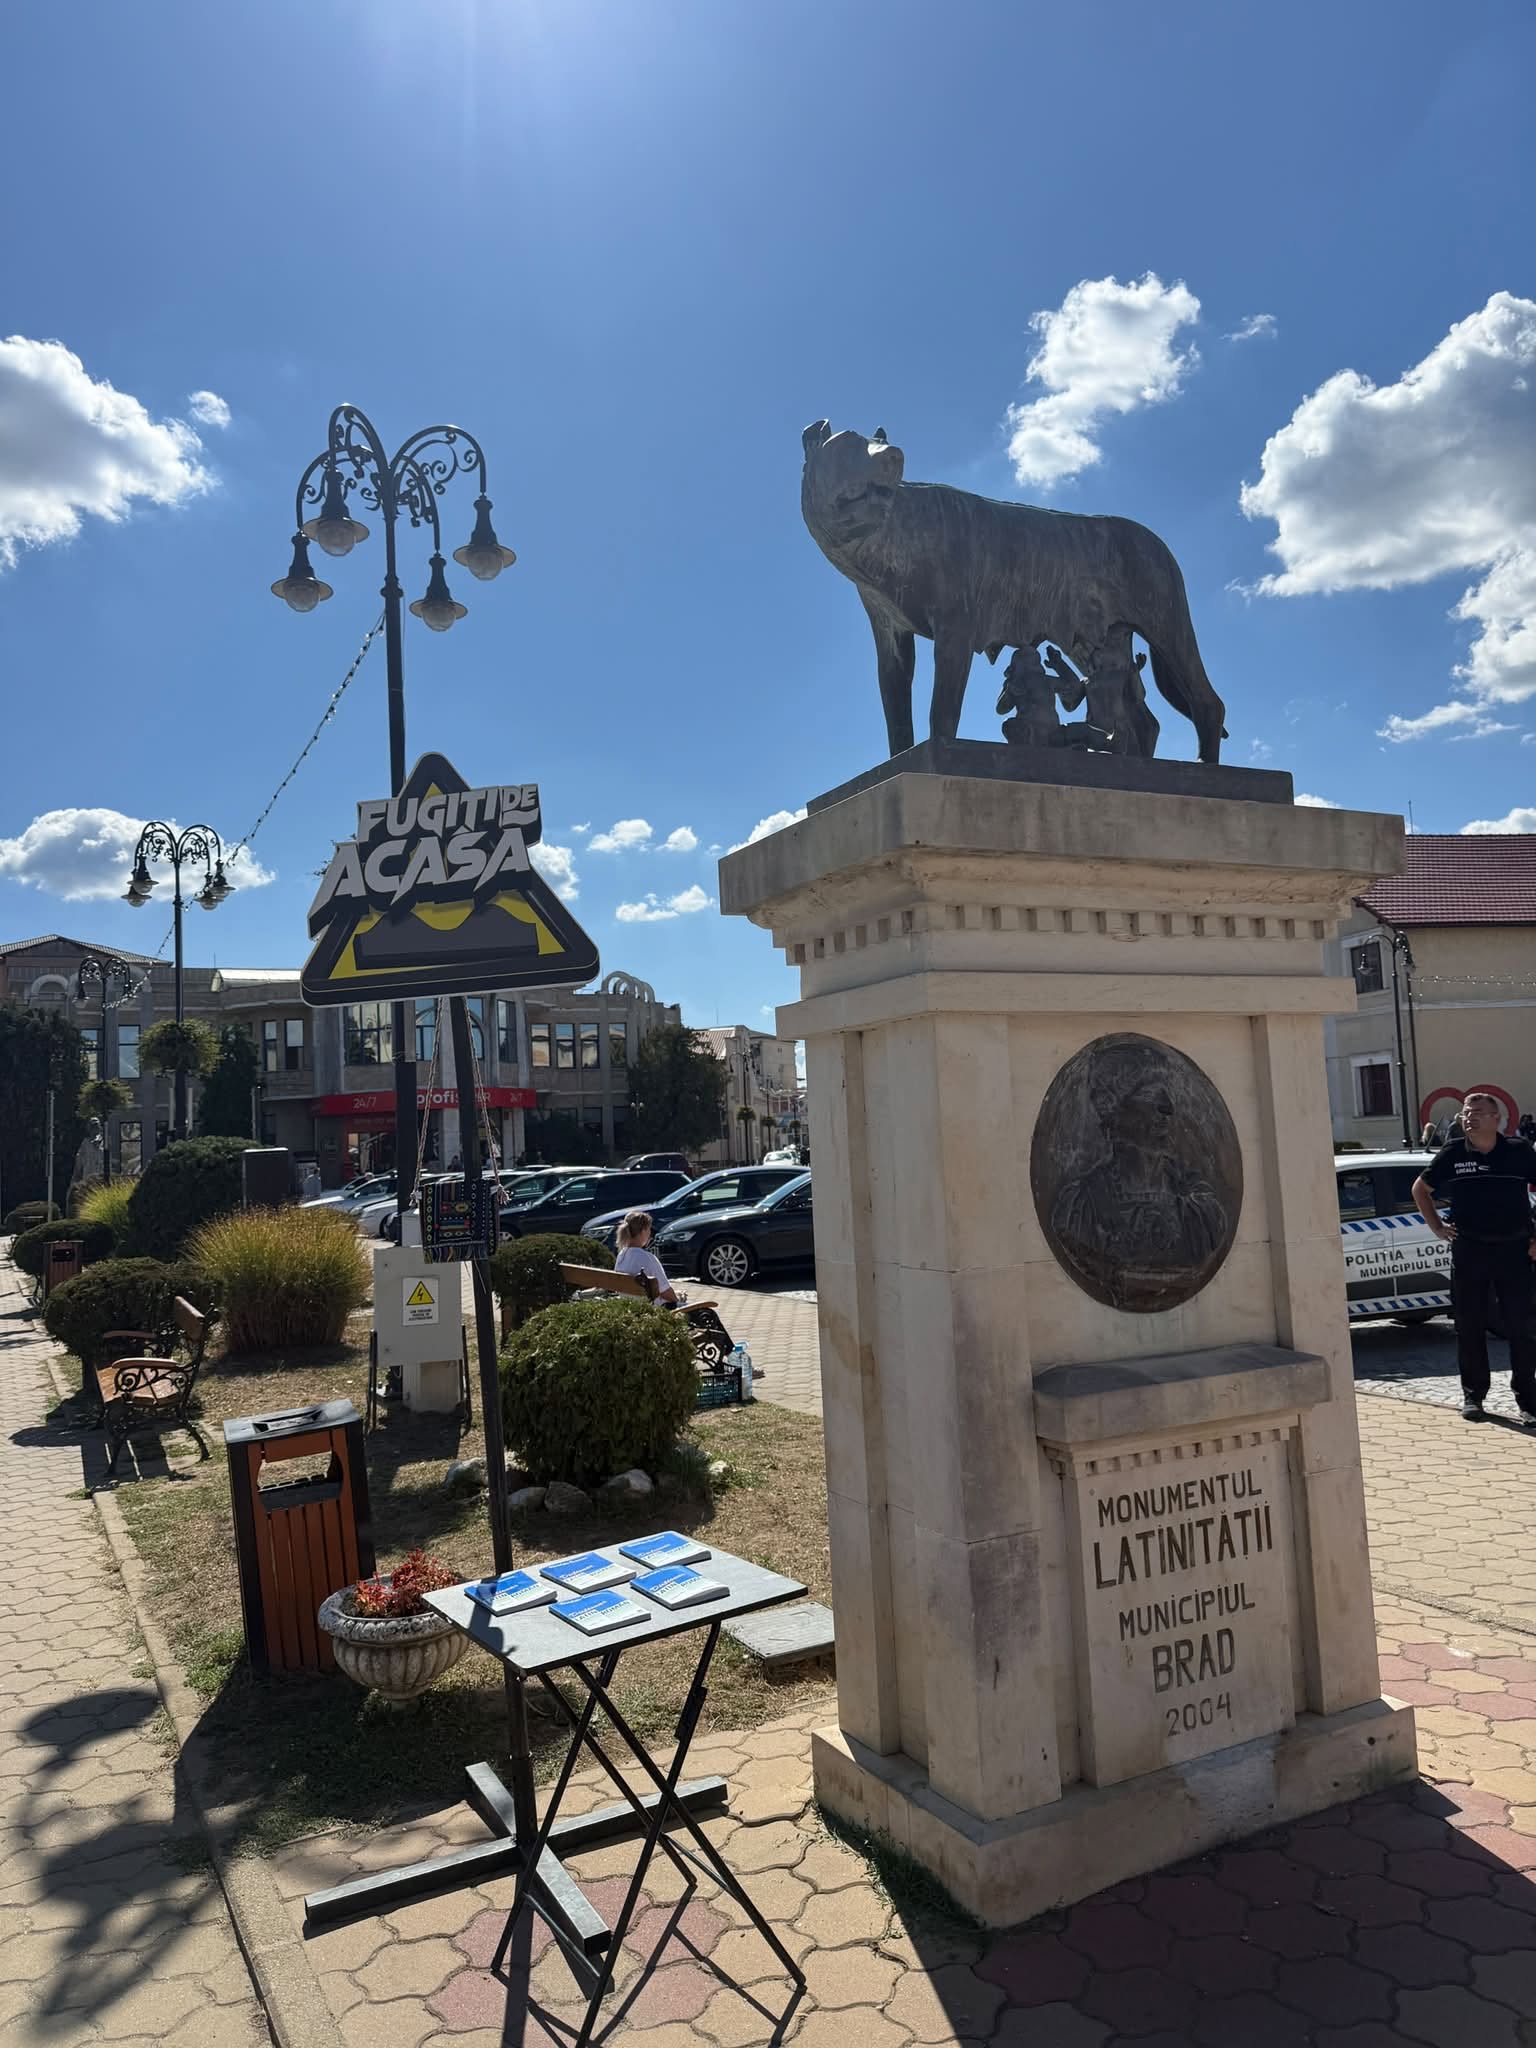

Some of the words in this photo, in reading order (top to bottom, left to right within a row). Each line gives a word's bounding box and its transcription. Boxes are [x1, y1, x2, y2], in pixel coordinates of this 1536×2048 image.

[502, 784, 538, 812] DE
[353, 1096, 377, 1109] 24/7
[416, 1090, 455, 1108] pofi
[1416, 1243, 1453, 1257] LOCA
[1360, 1260, 1431, 1279] MUNICIPIUL
[1434, 1258, 1451, 1268] BR
[1097, 1468, 1263, 1528] MONUMENTUL
[1118, 1582, 1256, 1641] MUNICIPIUL
[1152, 1628, 1236, 1693] BRAD
[1166, 1692, 1232, 1737] 2004
